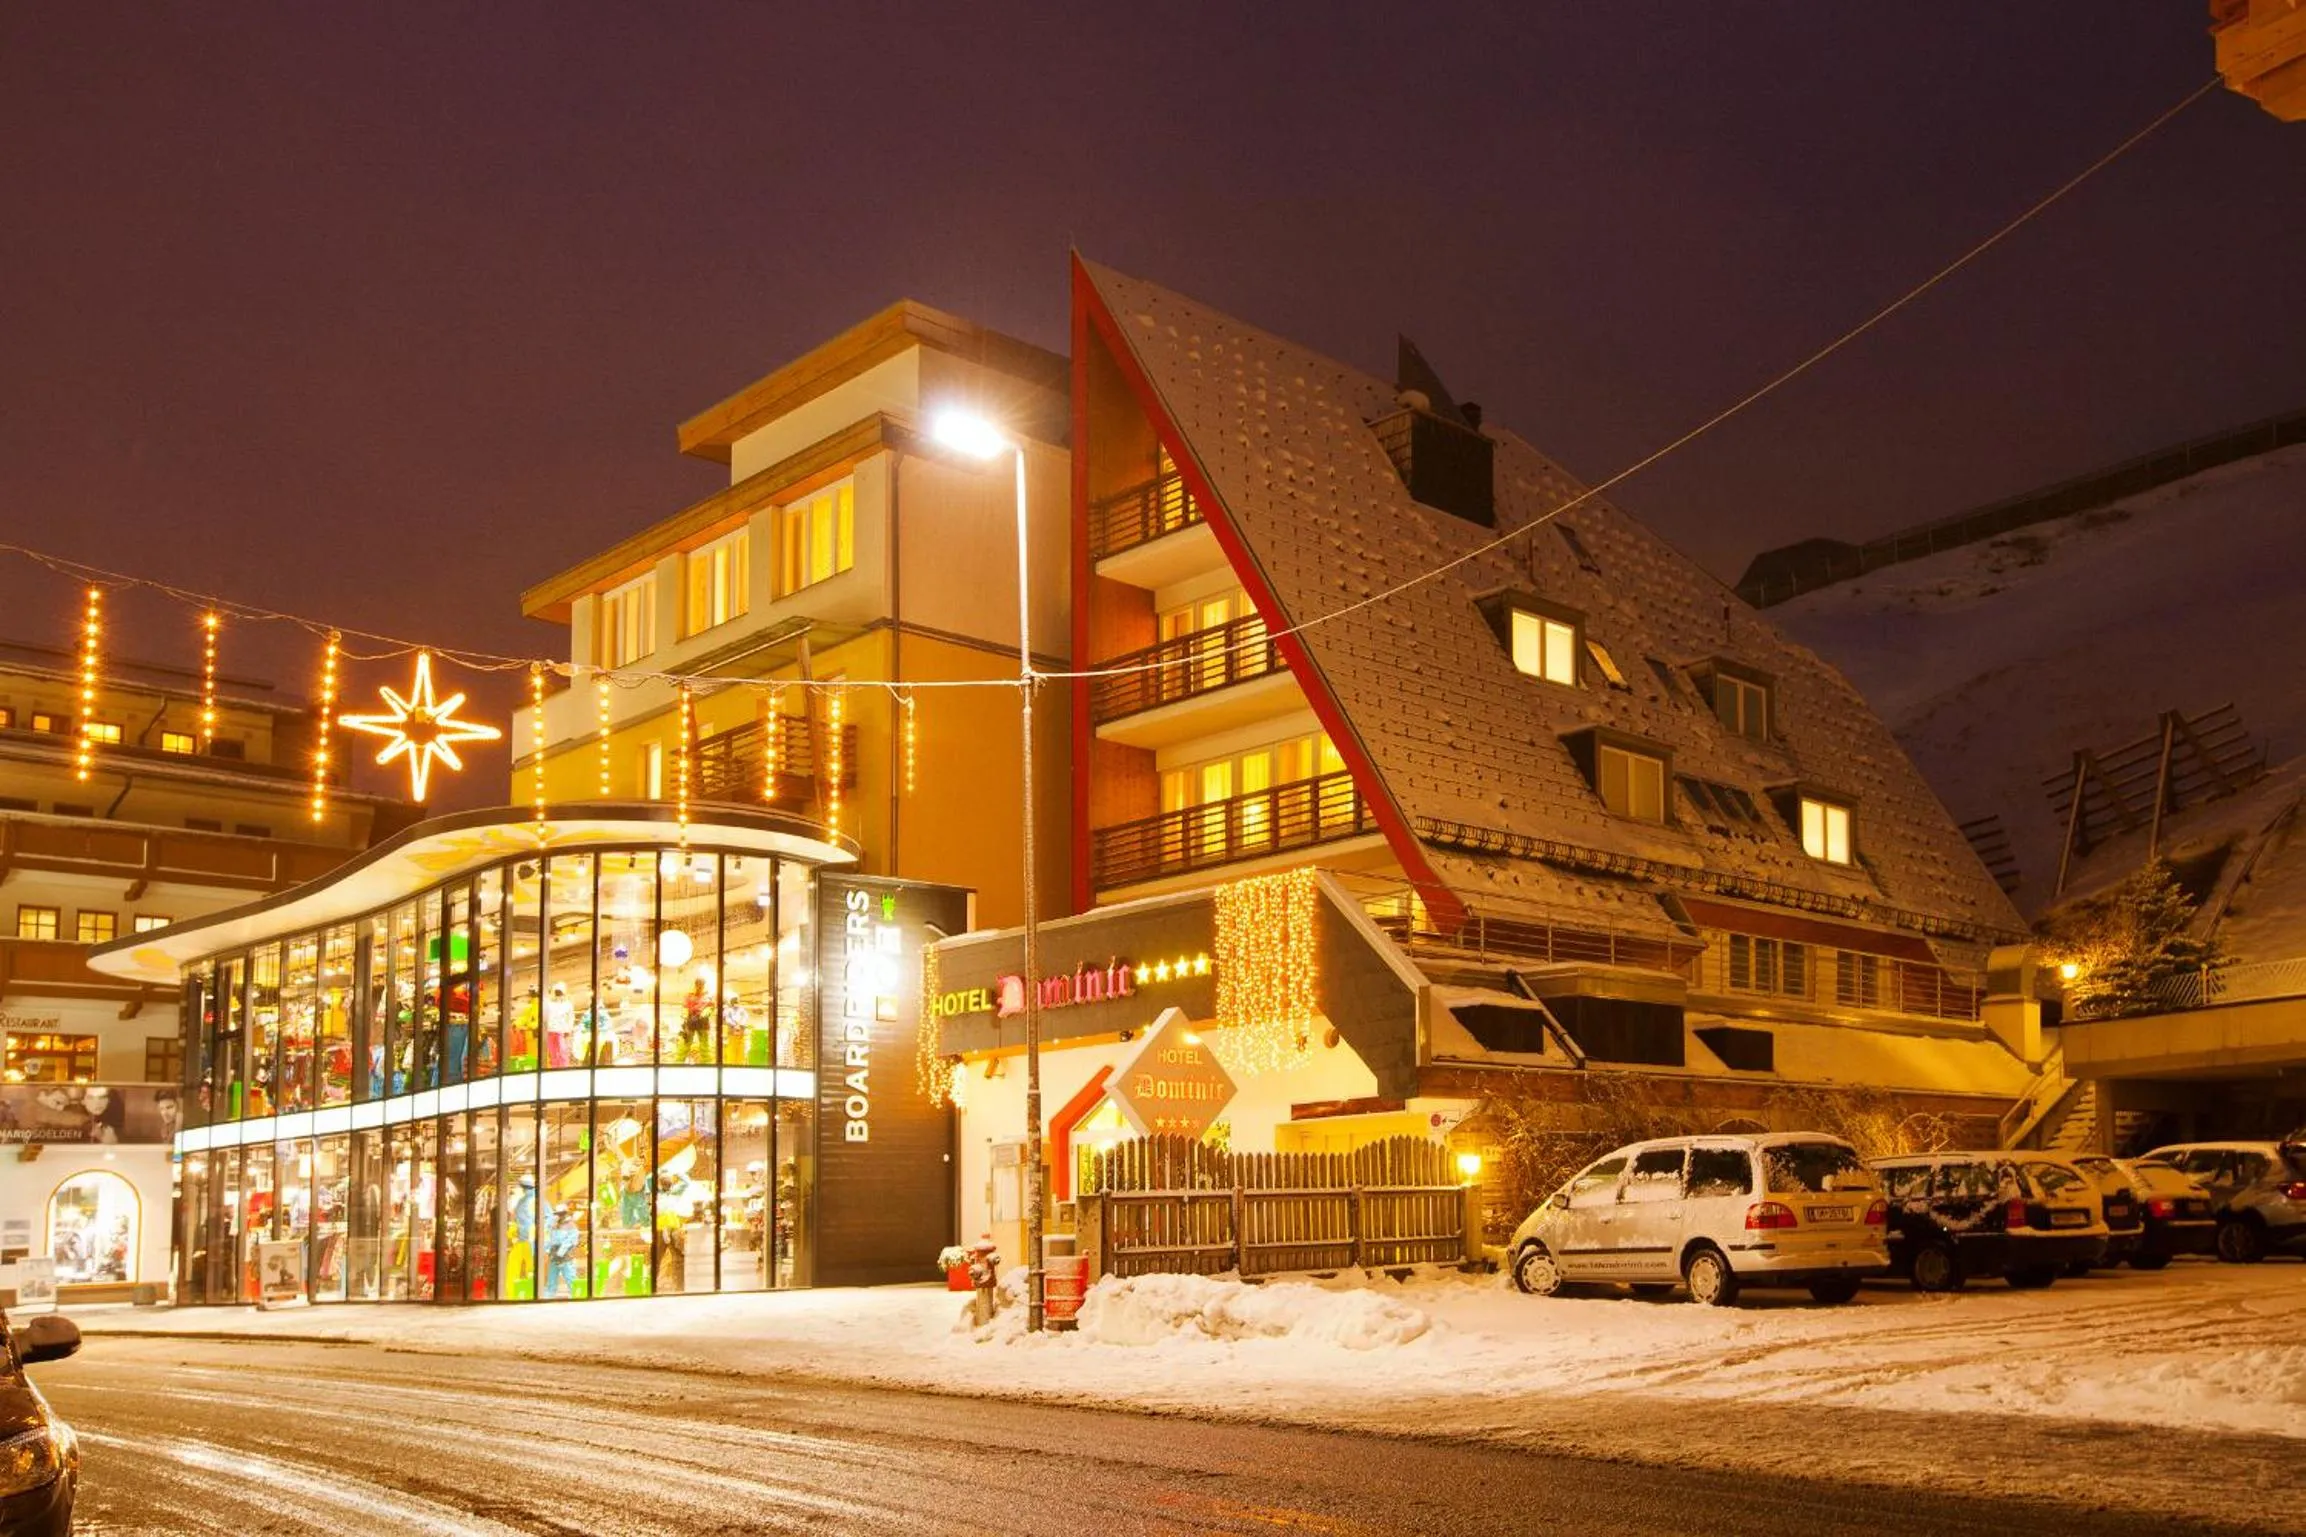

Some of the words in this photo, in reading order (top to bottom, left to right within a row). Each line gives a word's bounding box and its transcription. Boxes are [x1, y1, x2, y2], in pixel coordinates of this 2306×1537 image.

[845, 890, 869, 1142] BOARDRERS
[931, 988, 992, 1017] HOTEL
[1156, 1048, 1203, 1065] HOTEL
[1133, 1073, 1225, 1100] Dominic
